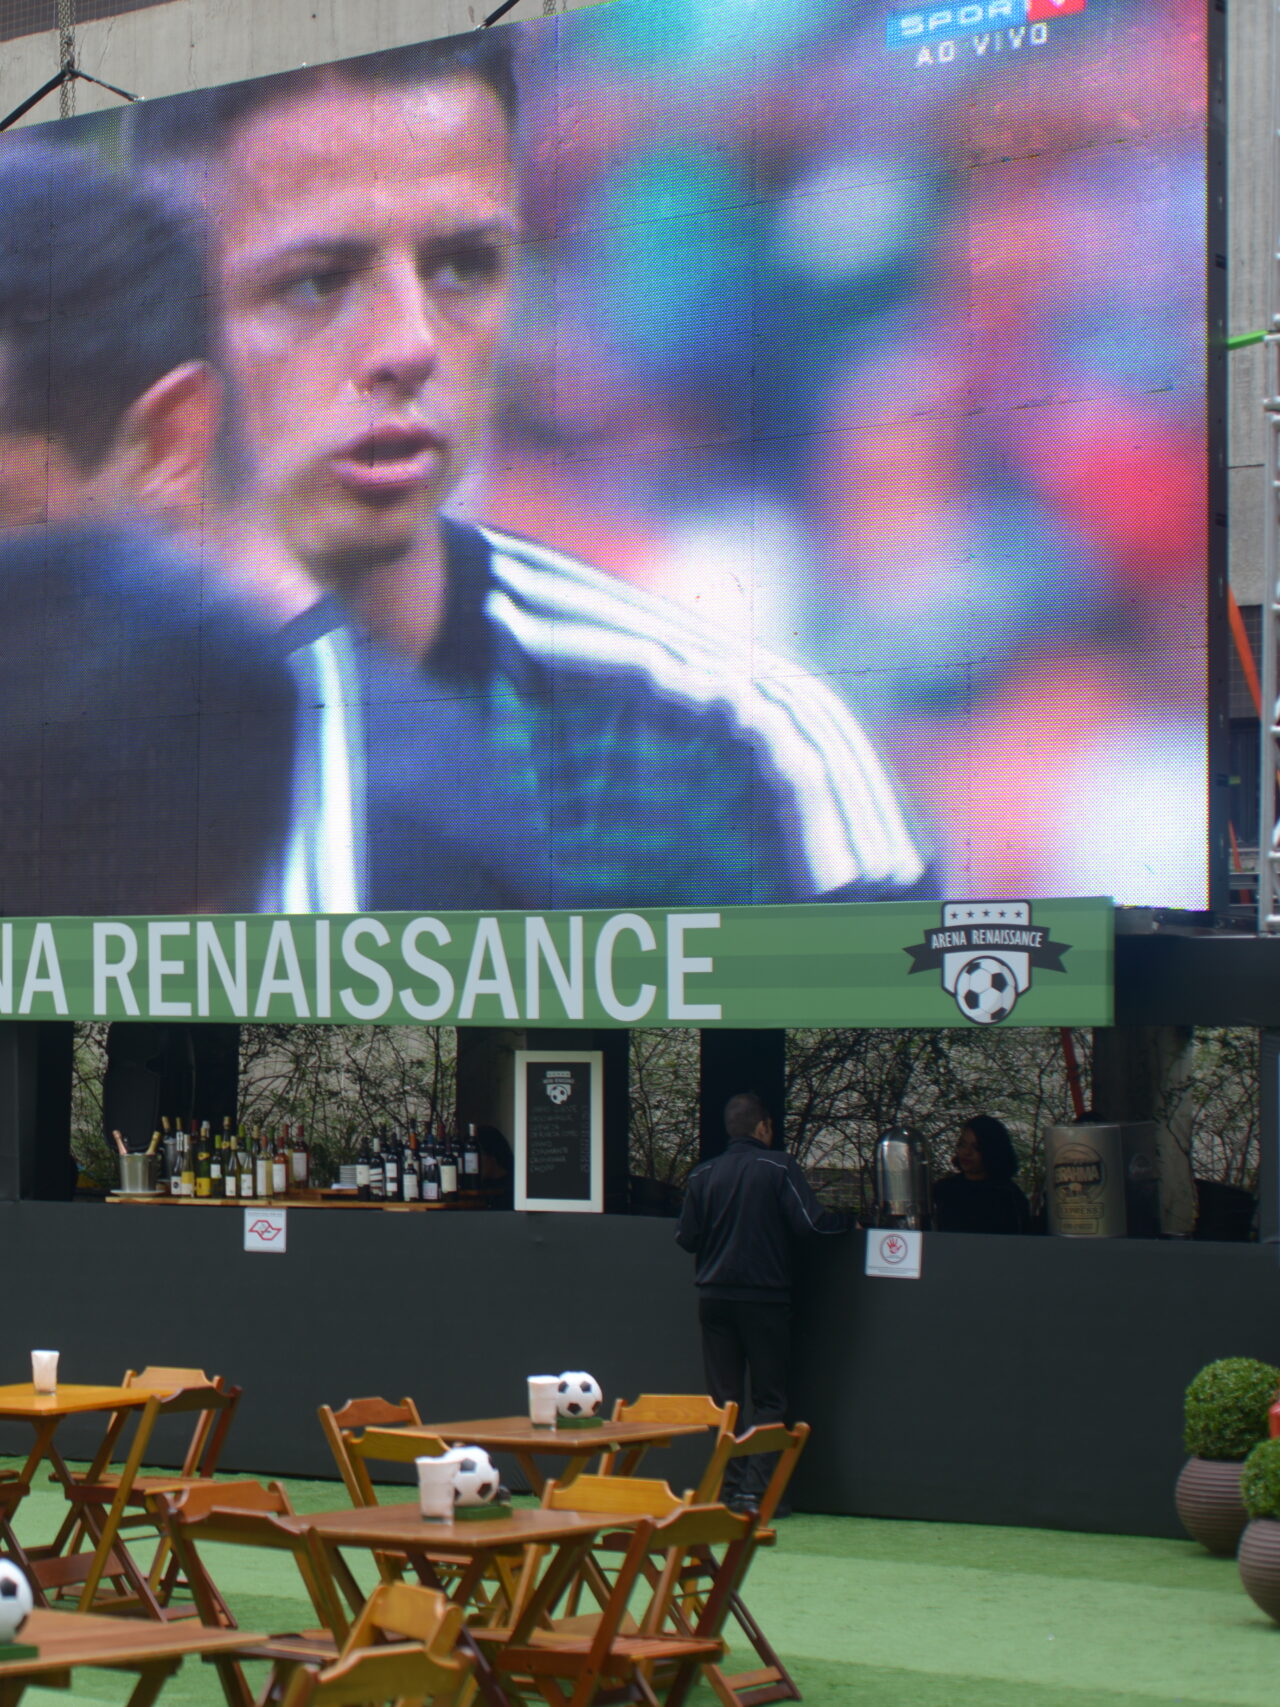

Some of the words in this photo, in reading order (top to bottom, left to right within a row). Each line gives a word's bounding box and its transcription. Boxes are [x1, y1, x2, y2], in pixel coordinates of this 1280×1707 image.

[916, 40, 955, 66] AO
[974, 22, 1047, 55] VIVO
[931, 930, 967, 949] ARENA
[972, 929, 1043, 948] RENAISSANCE
[92, 912, 721, 1021] RENAISSANCE
